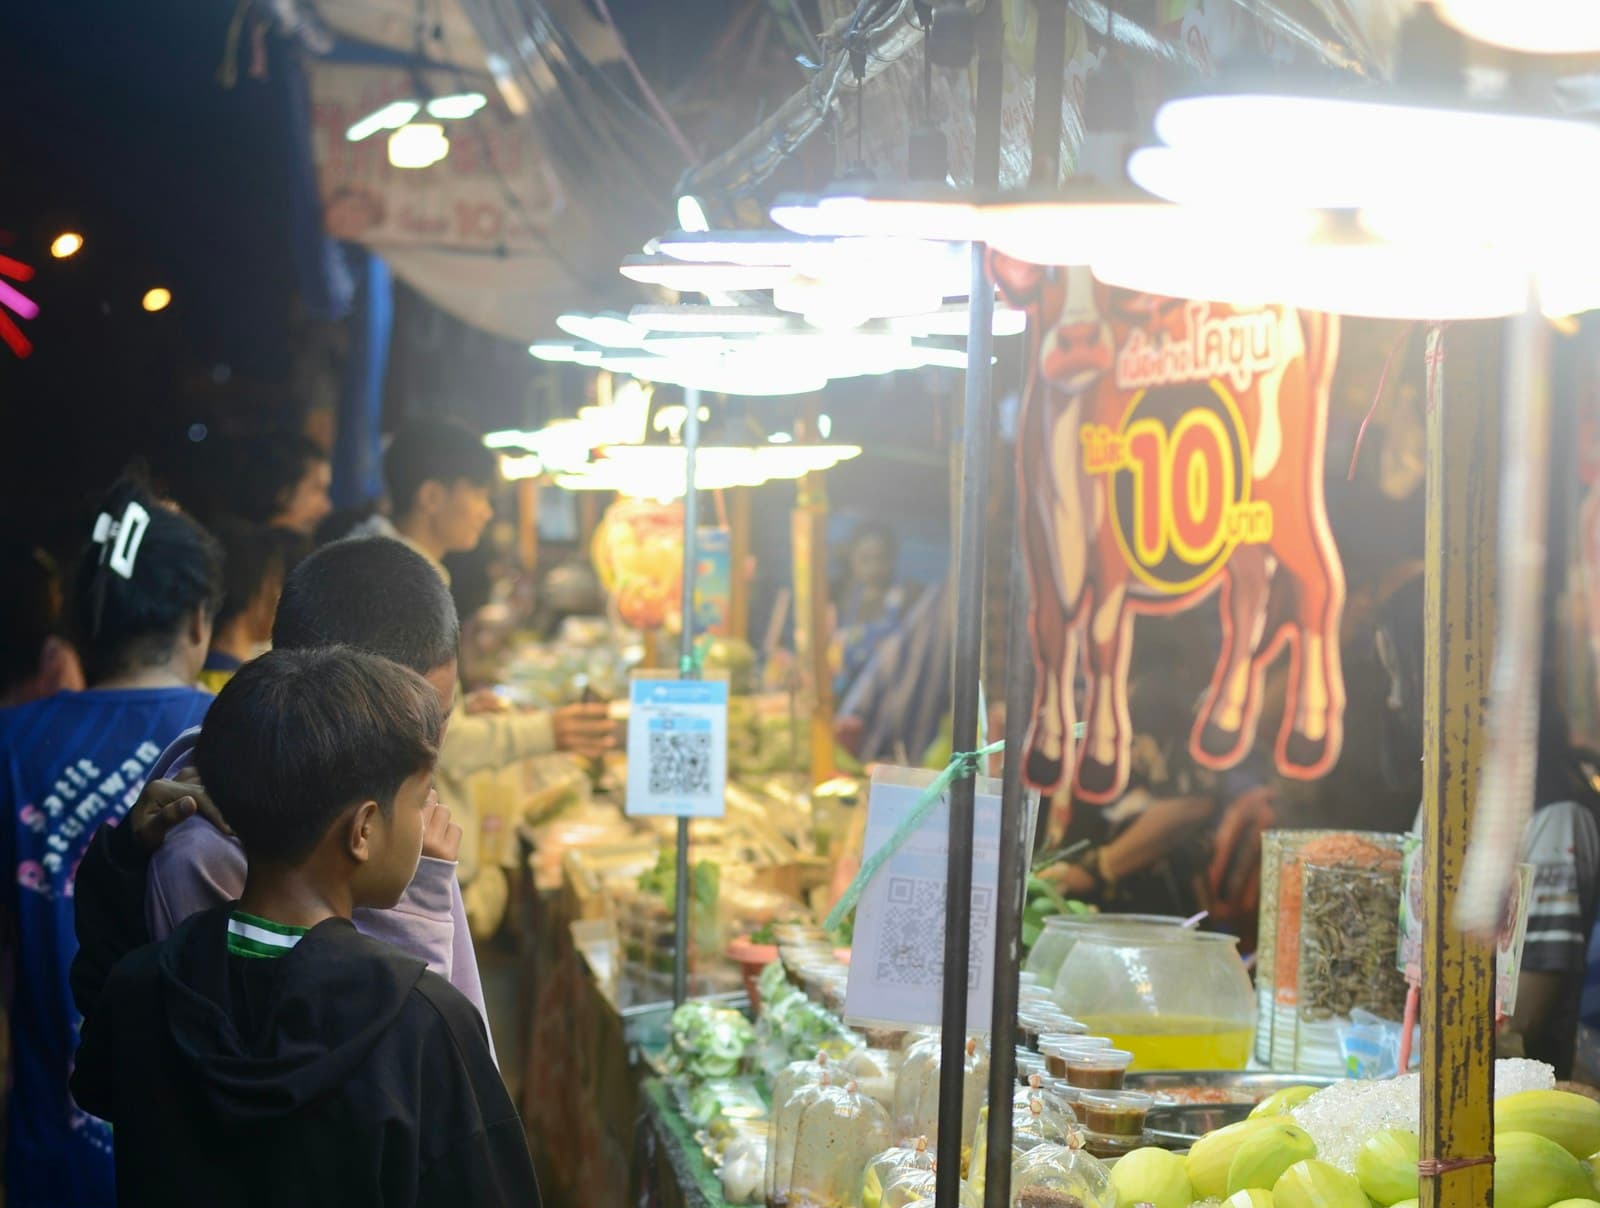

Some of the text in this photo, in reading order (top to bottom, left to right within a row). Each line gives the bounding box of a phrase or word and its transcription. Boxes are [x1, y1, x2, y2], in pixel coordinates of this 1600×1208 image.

[1127, 415, 1231, 560] 10
[16, 741, 161, 899] Patumwan
[19, 758, 101, 833] Satit
